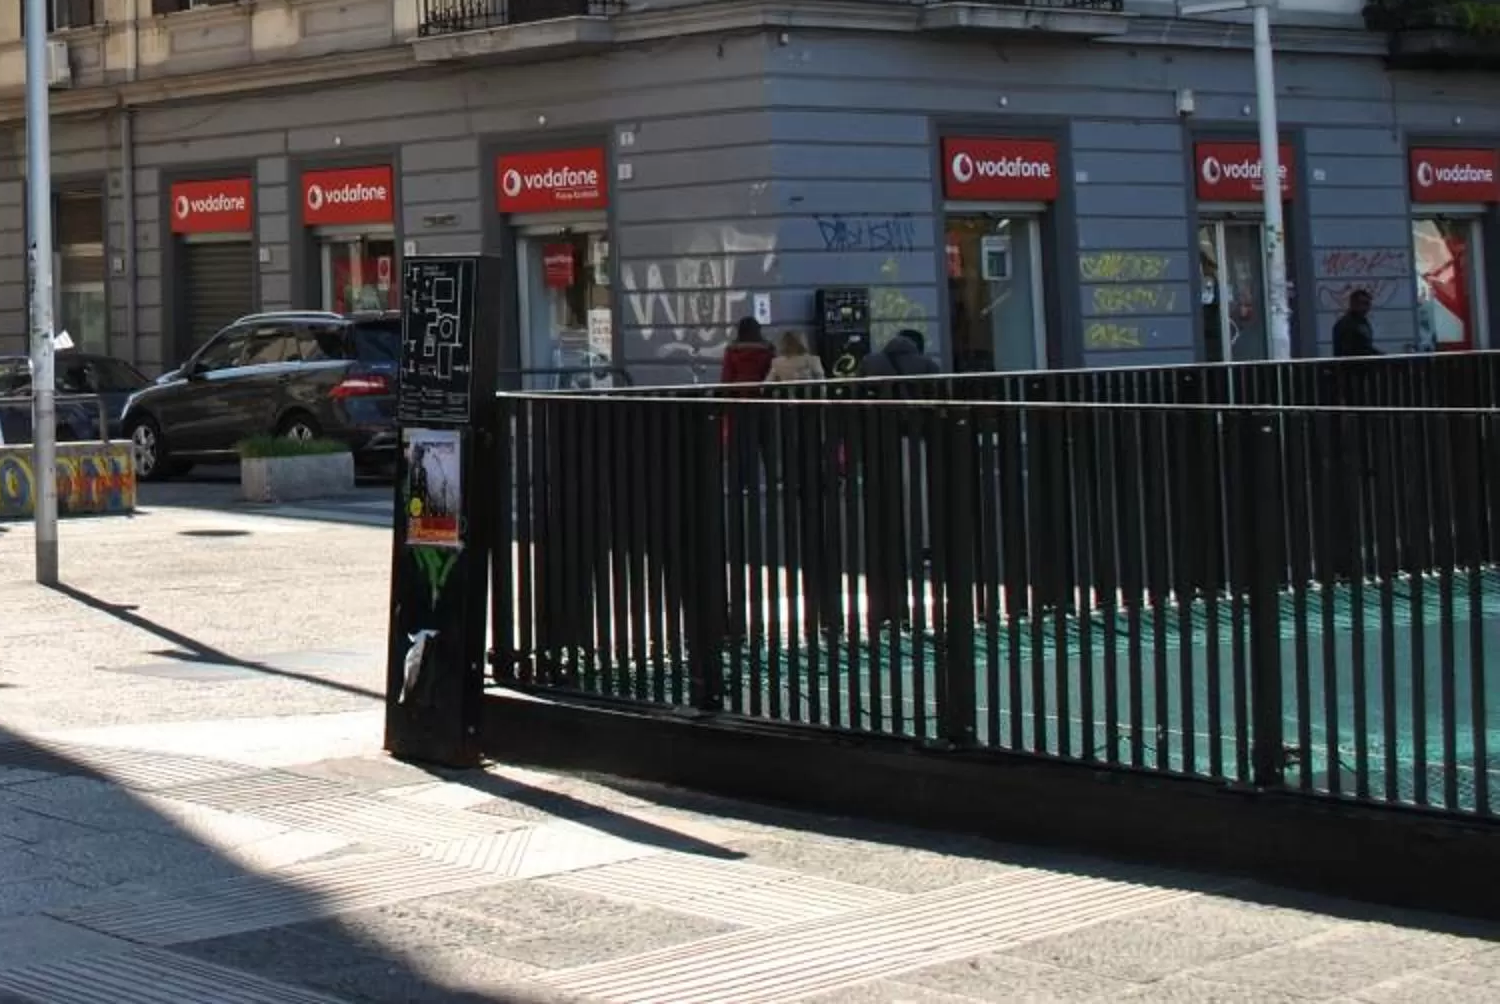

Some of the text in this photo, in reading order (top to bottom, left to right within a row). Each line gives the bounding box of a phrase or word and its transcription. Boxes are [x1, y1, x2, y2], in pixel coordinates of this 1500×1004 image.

[524, 167, 598, 189] vodafone
[976, 158, 1050, 178] vodafone
[1223, 157, 1288, 179] vodafe
[1435, 163, 1493, 183] vodafone
[191, 194, 245, 213] vodafone
[325, 182, 387, 204] vodafone
